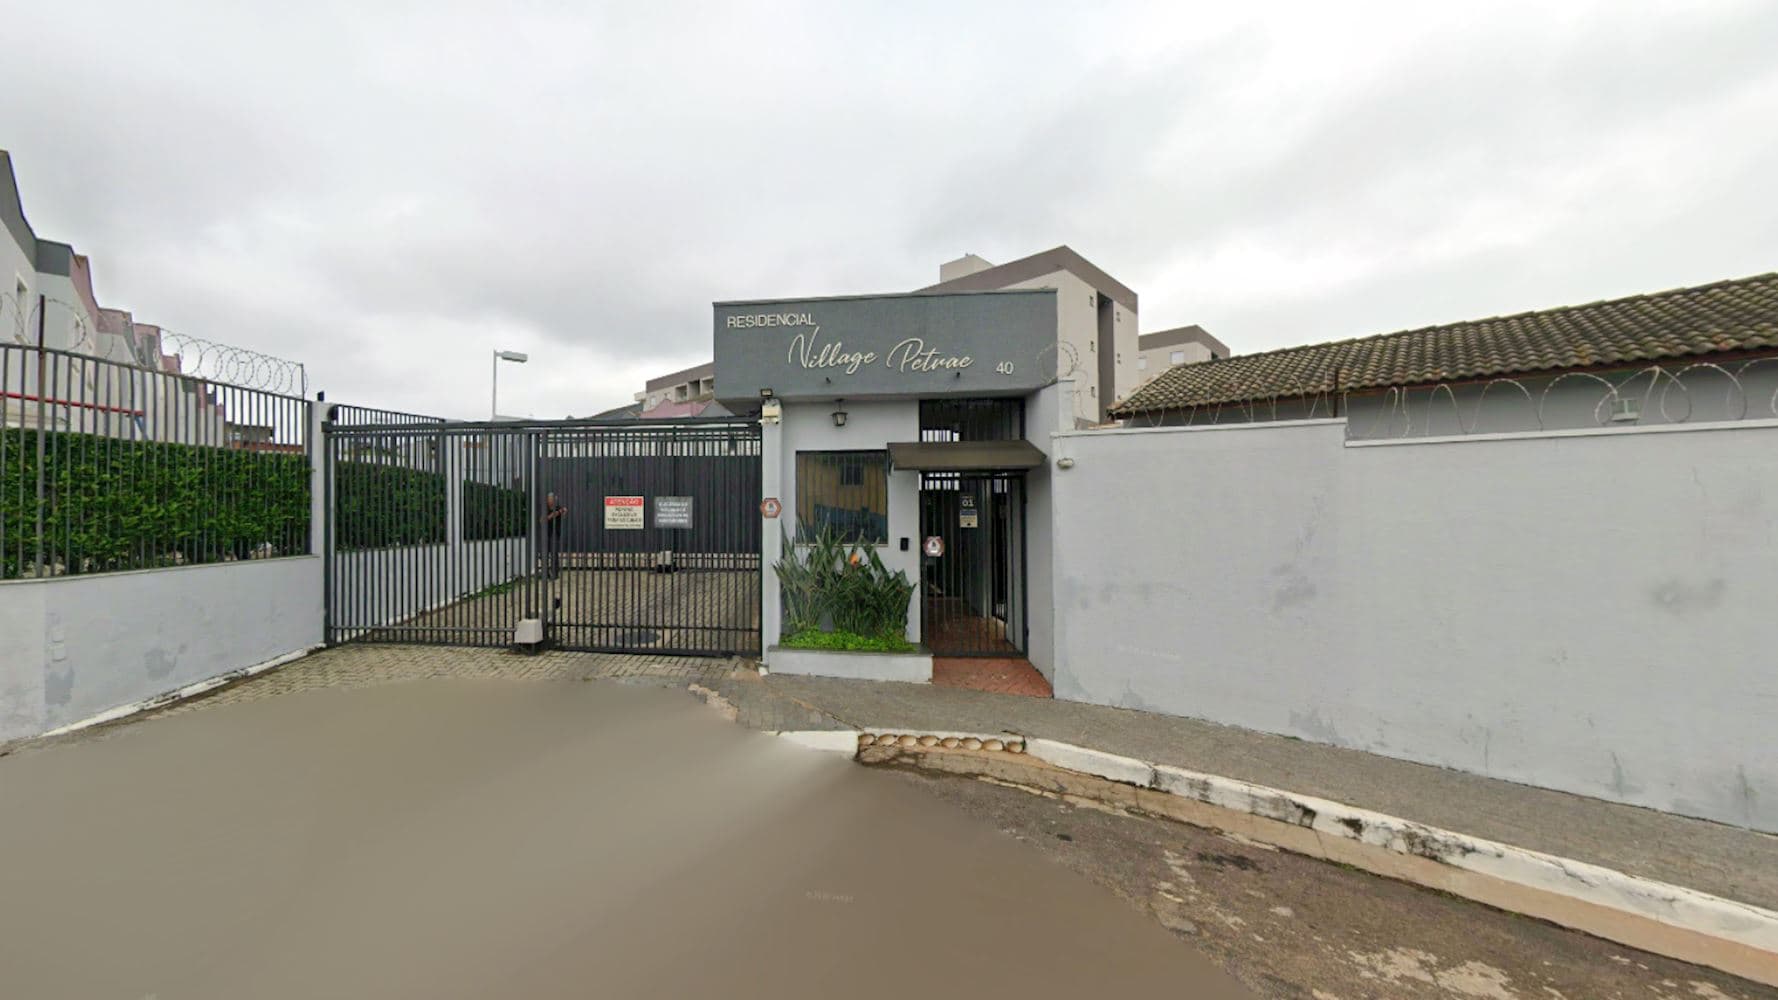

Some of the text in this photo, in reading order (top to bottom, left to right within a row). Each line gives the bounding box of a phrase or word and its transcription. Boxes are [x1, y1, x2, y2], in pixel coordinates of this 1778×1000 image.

[727, 313, 816, 328] RESIDENCIAL
[788, 326, 974, 374] Village Petrae
[995, 361, 1014, 375] 40
